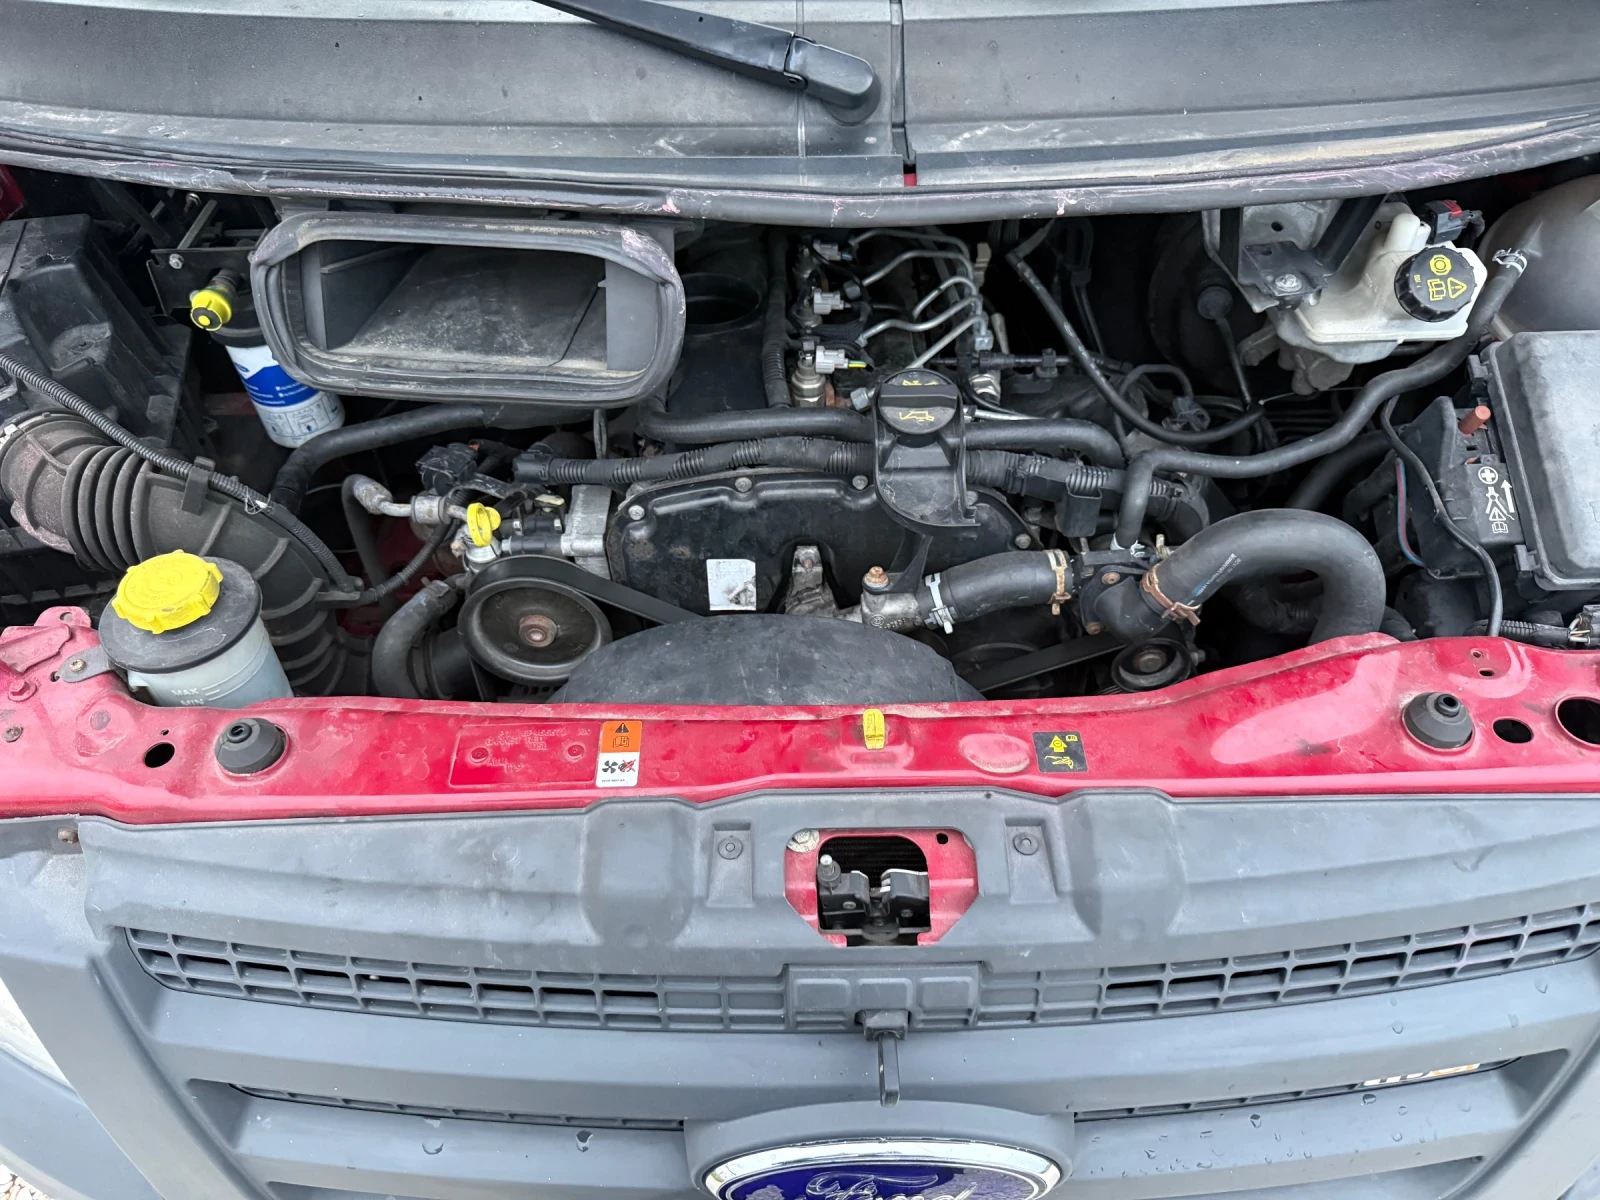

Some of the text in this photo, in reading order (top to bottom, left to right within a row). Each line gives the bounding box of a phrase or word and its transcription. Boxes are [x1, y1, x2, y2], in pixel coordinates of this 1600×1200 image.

[171, 688, 199, 696] MAX
[180, 698, 204, 706] MIN
[527, 734, 545, 743] RED
